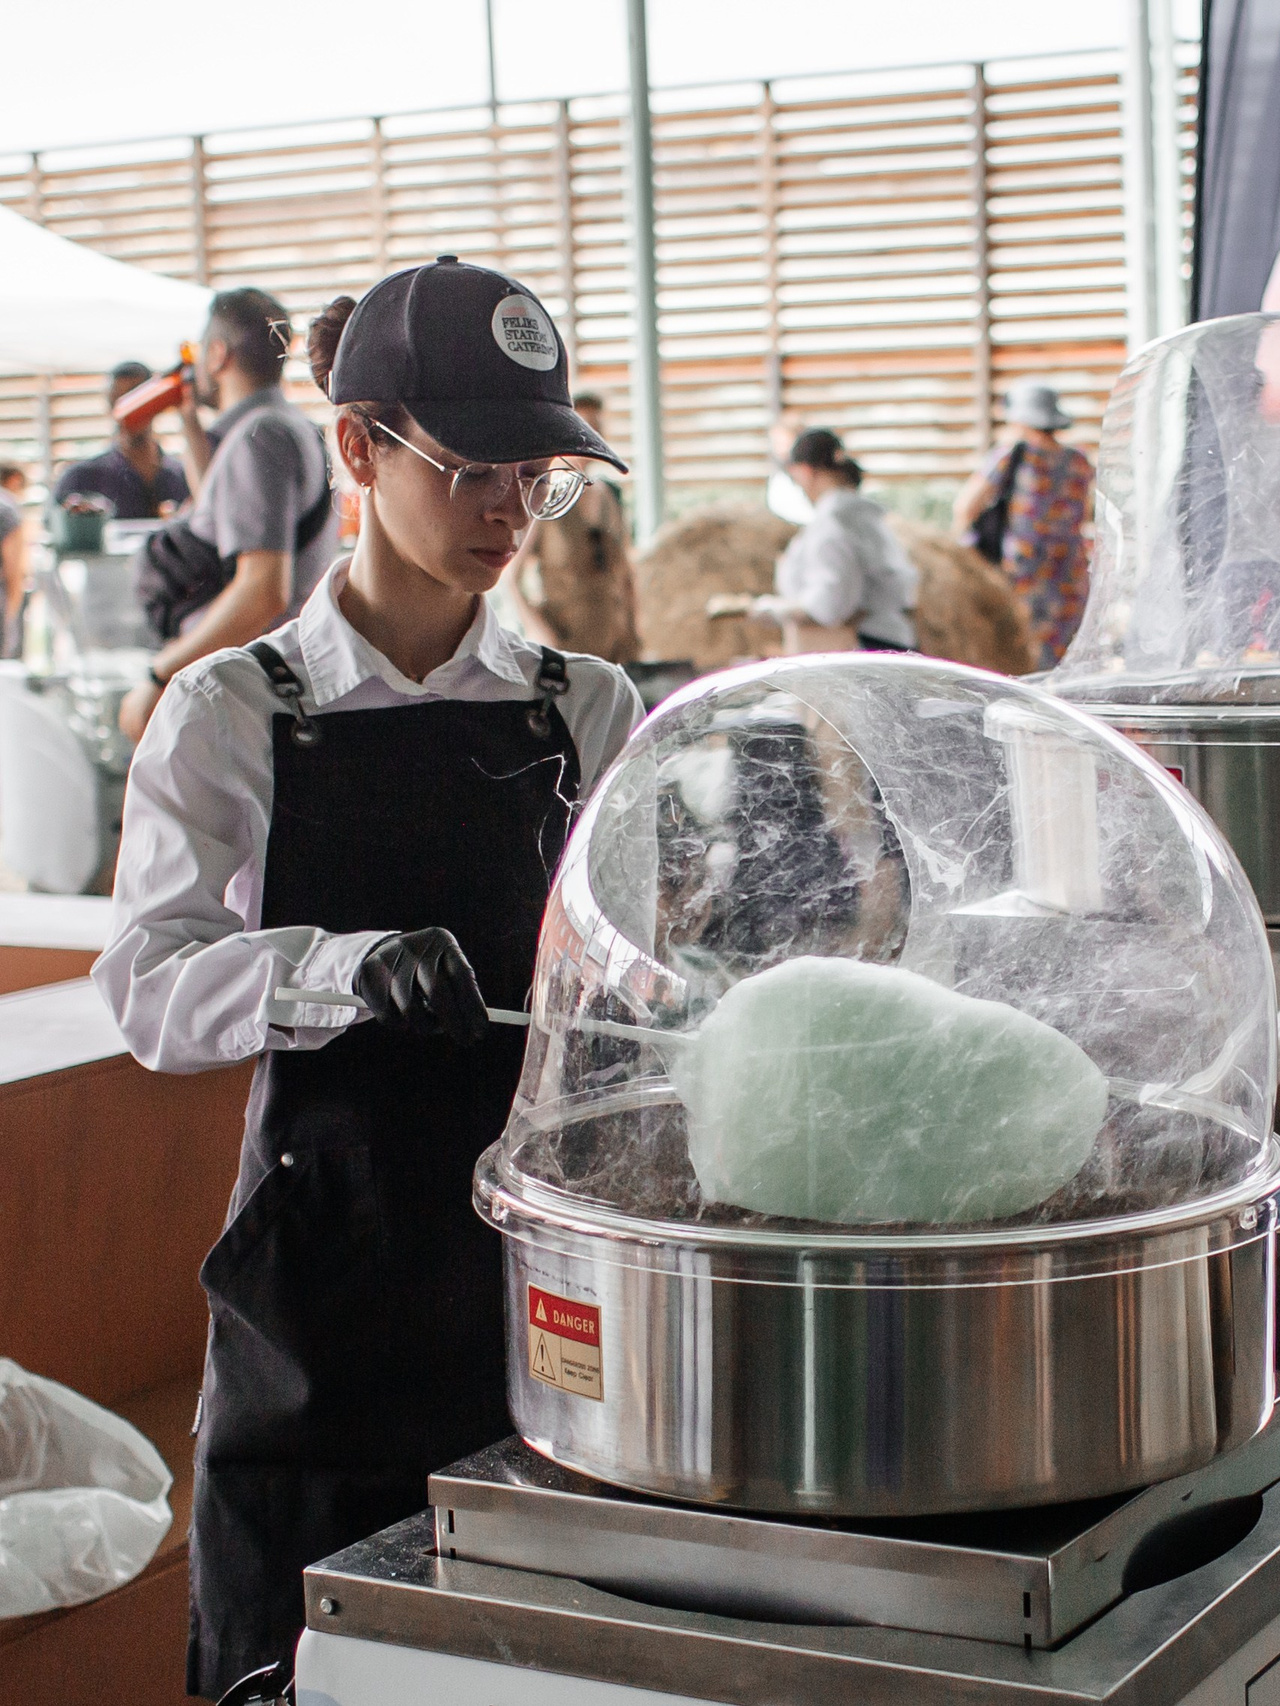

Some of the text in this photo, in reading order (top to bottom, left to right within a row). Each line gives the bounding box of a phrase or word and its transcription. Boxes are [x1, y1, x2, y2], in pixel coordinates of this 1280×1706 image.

[504, 329, 548, 343] STATION
[507, 341, 556, 358] CATERING
[553, 1309, 595, 1335] DANGER
